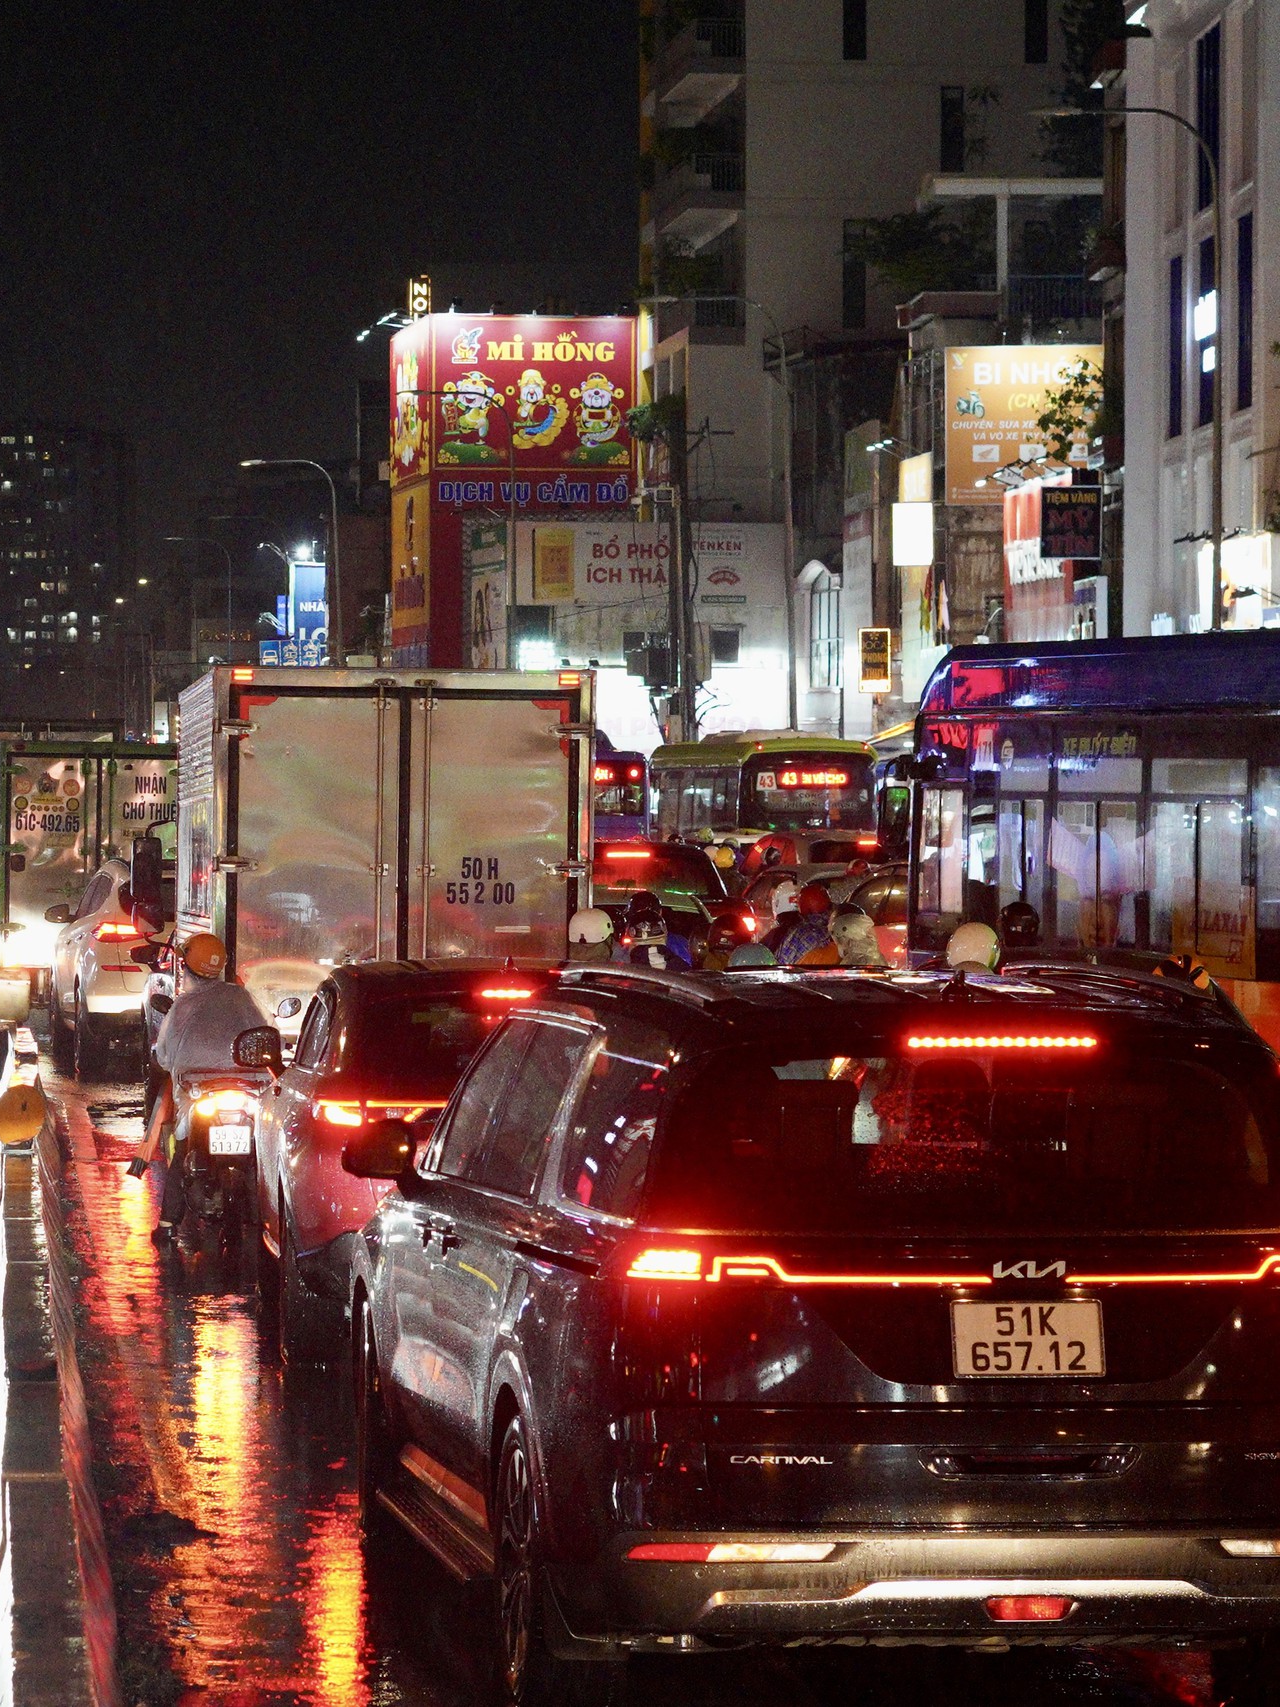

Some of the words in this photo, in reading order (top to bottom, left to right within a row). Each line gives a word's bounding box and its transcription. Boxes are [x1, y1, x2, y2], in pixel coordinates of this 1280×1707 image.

[974, 361, 1001, 385] BI
[439, 481, 494, 507] DỊCH
[500, 481, 531, 508] VỤ
[592, 534, 620, 560] BỔ
[627, 534, 669, 560] PHỔ
[586, 564, 621, 584] ÍCH
[628, 564, 668, 587] THẬ
[135, 772, 167, 797] NHẬN
[759, 775, 774, 788] 43
[782, 772, 798, 785] 43
[122, 795, 146, 820] CHỞ
[15, 813, 80, 833] 61C-492.65
[993, 1260, 1066, 1279] KIA
[995, 1306, 1058, 1337] 51K
[971, 1341, 1087, 1372] 657.12
[730, 1455, 833, 1465] CARNIVAL
